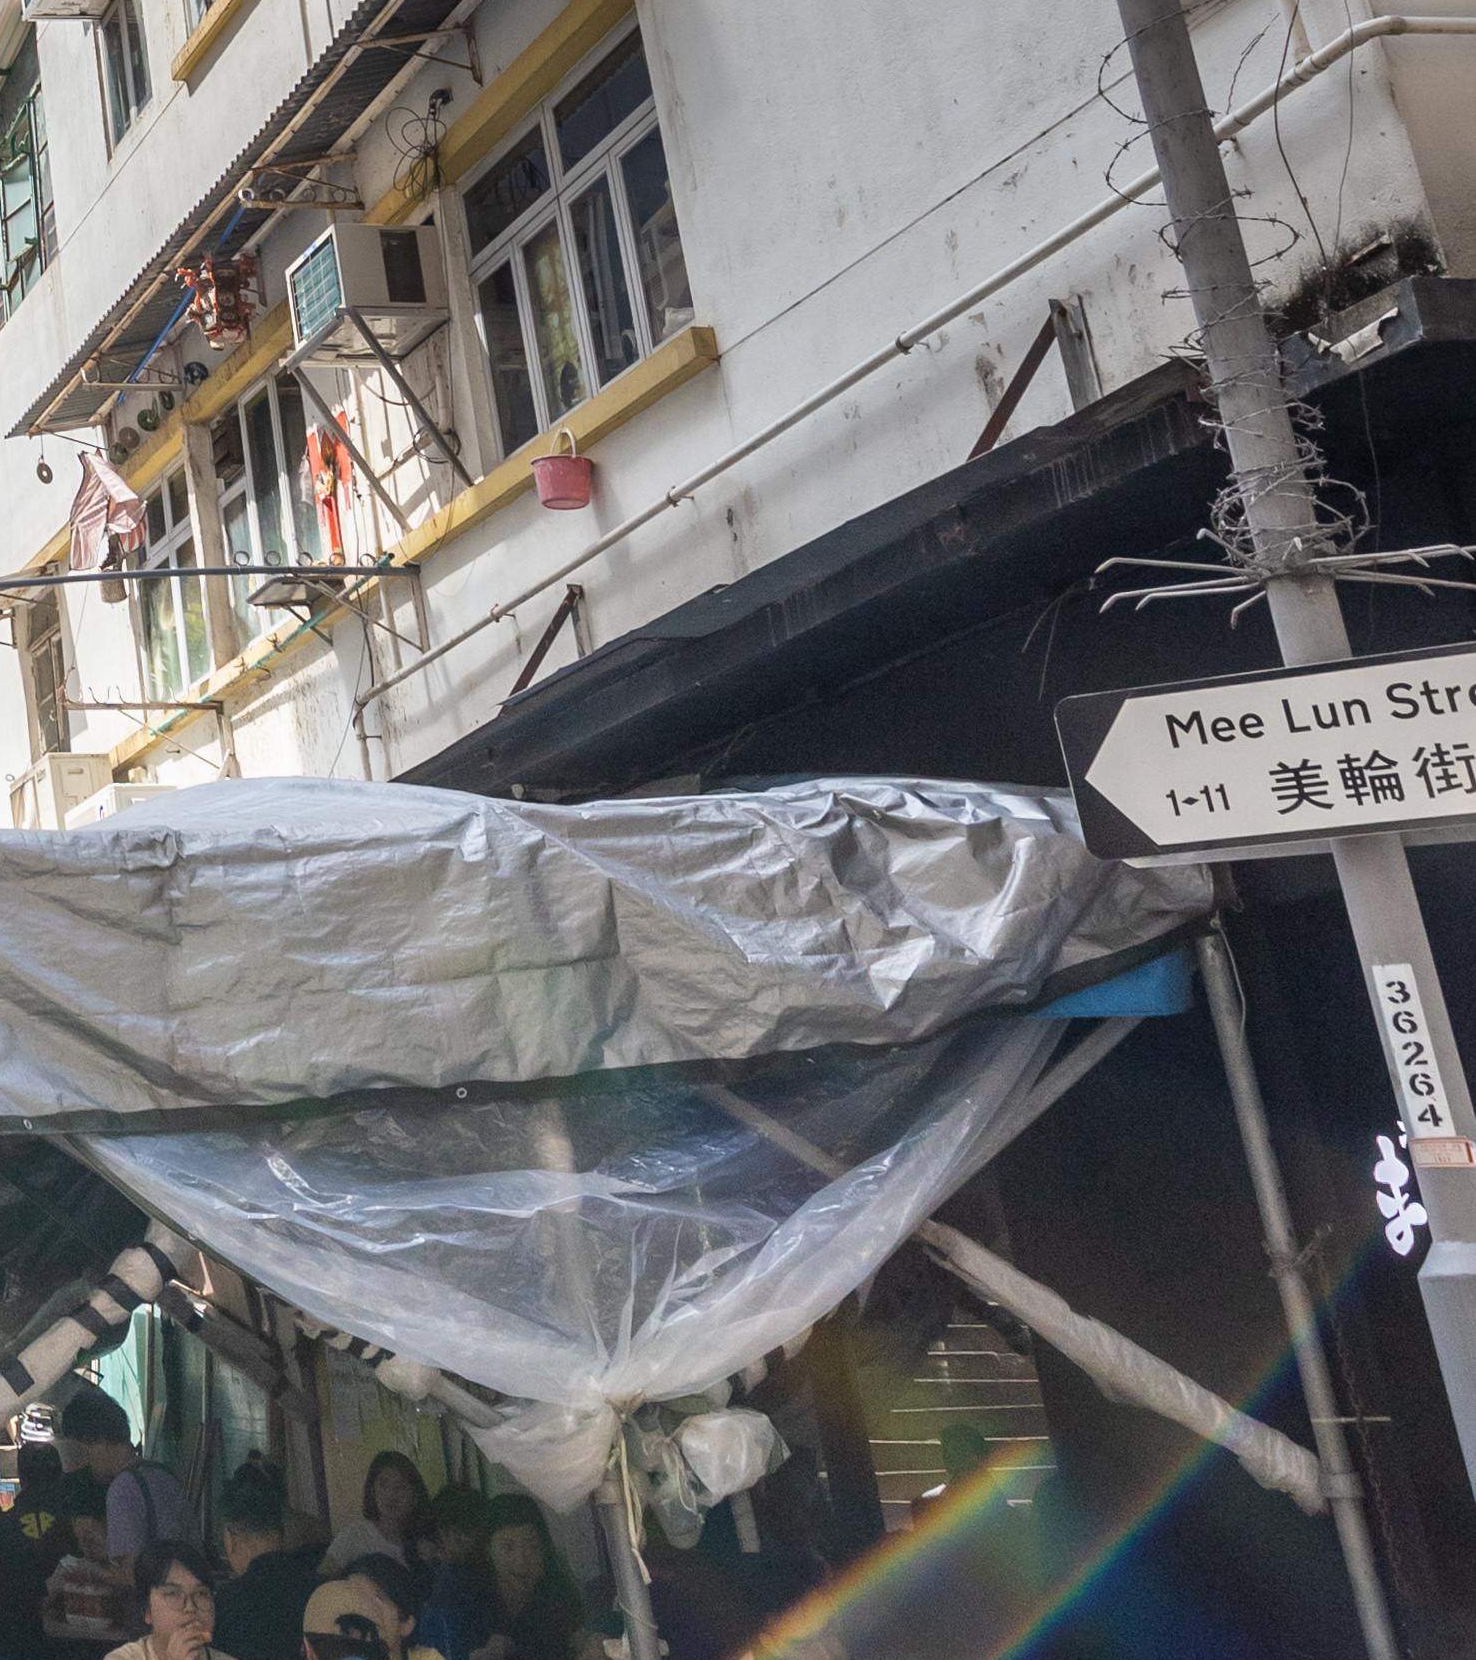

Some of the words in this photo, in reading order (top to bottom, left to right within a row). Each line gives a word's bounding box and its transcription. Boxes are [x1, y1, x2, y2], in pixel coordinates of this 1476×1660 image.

[1165, 710, 1265, 749] Mee
[1281, 697, 1372, 734] Lun
[1385, 679, 1476, 720] Str
[1268, 742, 1476, 815] 美輪街
[1385, 980, 1443, 1128] 36264
